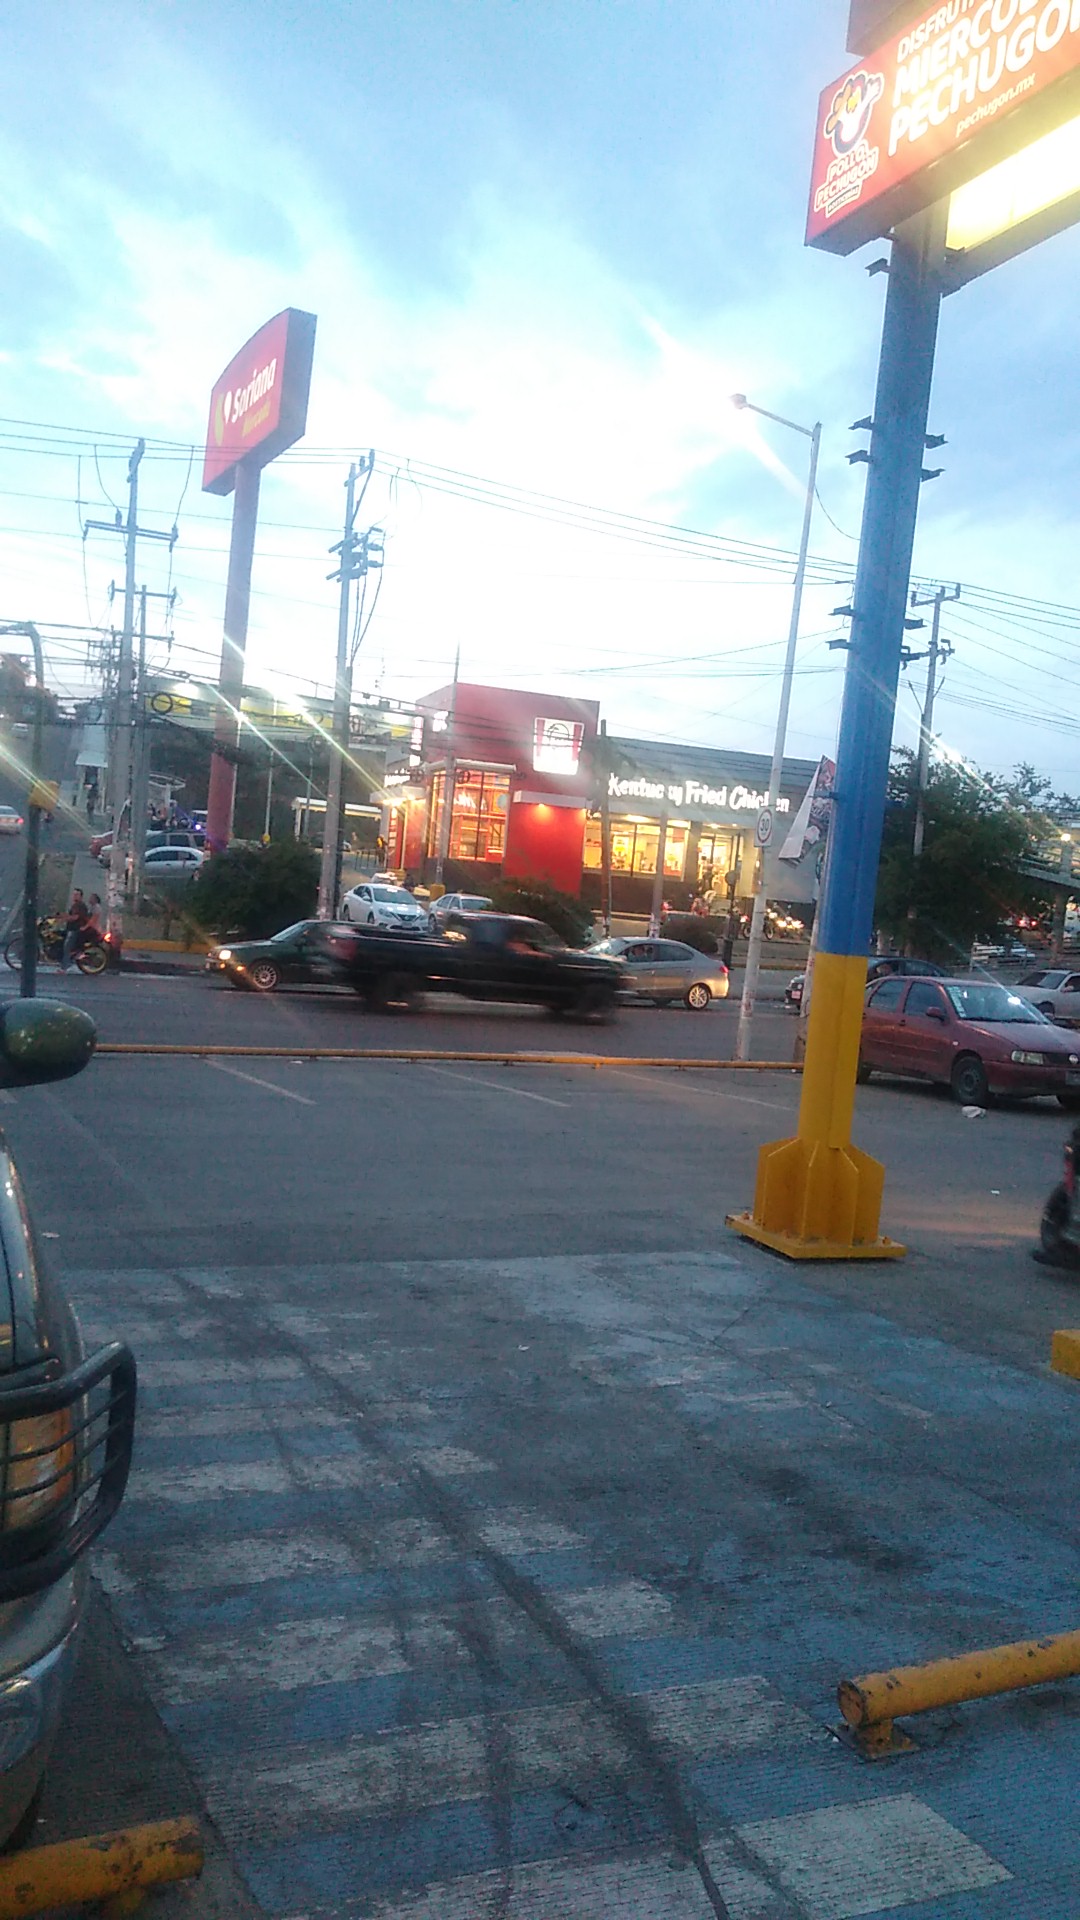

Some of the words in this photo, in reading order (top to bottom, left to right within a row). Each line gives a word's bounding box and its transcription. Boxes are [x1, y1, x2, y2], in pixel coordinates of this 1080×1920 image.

[955, 72, 1036, 138] pechugon.mx
[816, 151, 876, 208] PECHUGON
[829, 143, 866, 182] POLLO
[231, 358, 277, 424] Soriana
[685, 780, 727, 806] Fried
[759, 818, 770, 832] 30
